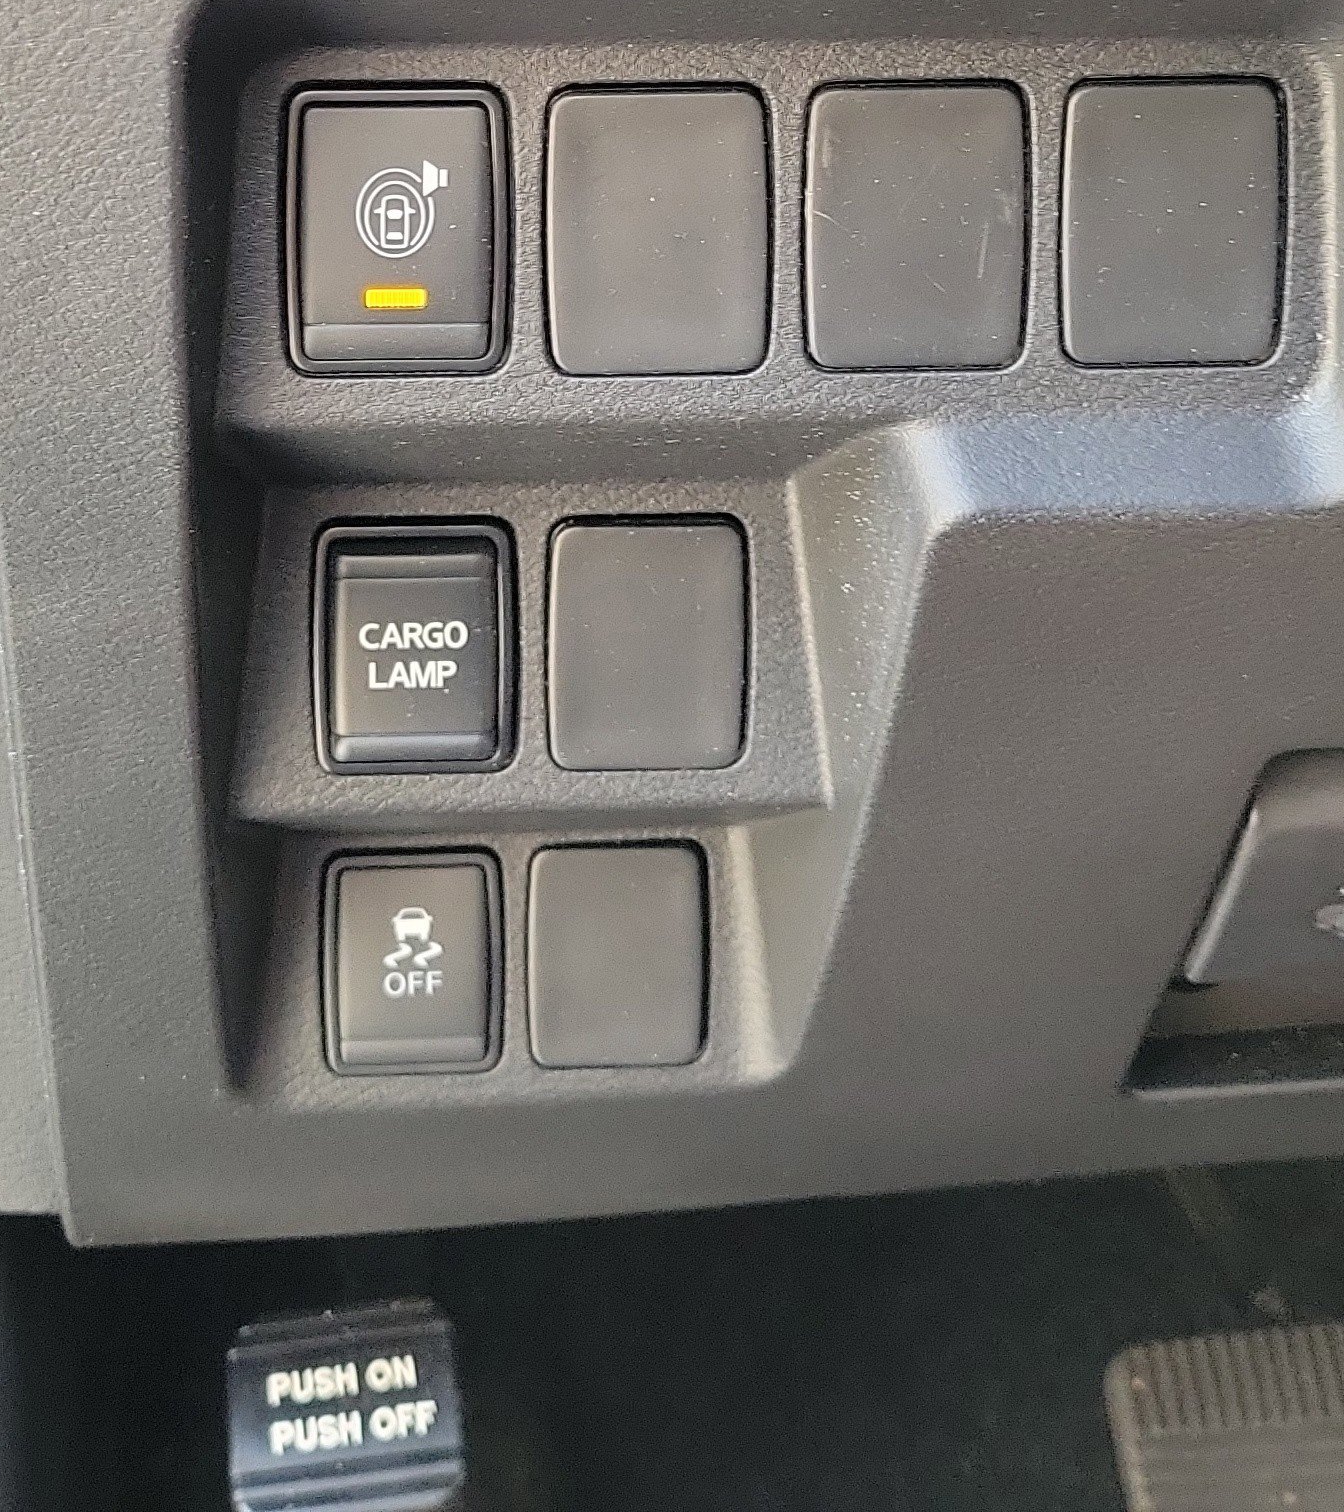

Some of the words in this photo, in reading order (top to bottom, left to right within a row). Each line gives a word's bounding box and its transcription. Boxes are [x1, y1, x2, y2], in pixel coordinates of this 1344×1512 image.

[358, 620, 469, 651] CARGO
[367, 660, 457, 690] LAMP
[383, 970, 444, 997] OFF
[265, 1361, 360, 1407] PUSH
[364, 1354, 418, 1393] ON
[268, 1409, 363, 1457] PUSH
[368, 1399, 438, 1441] OFF
